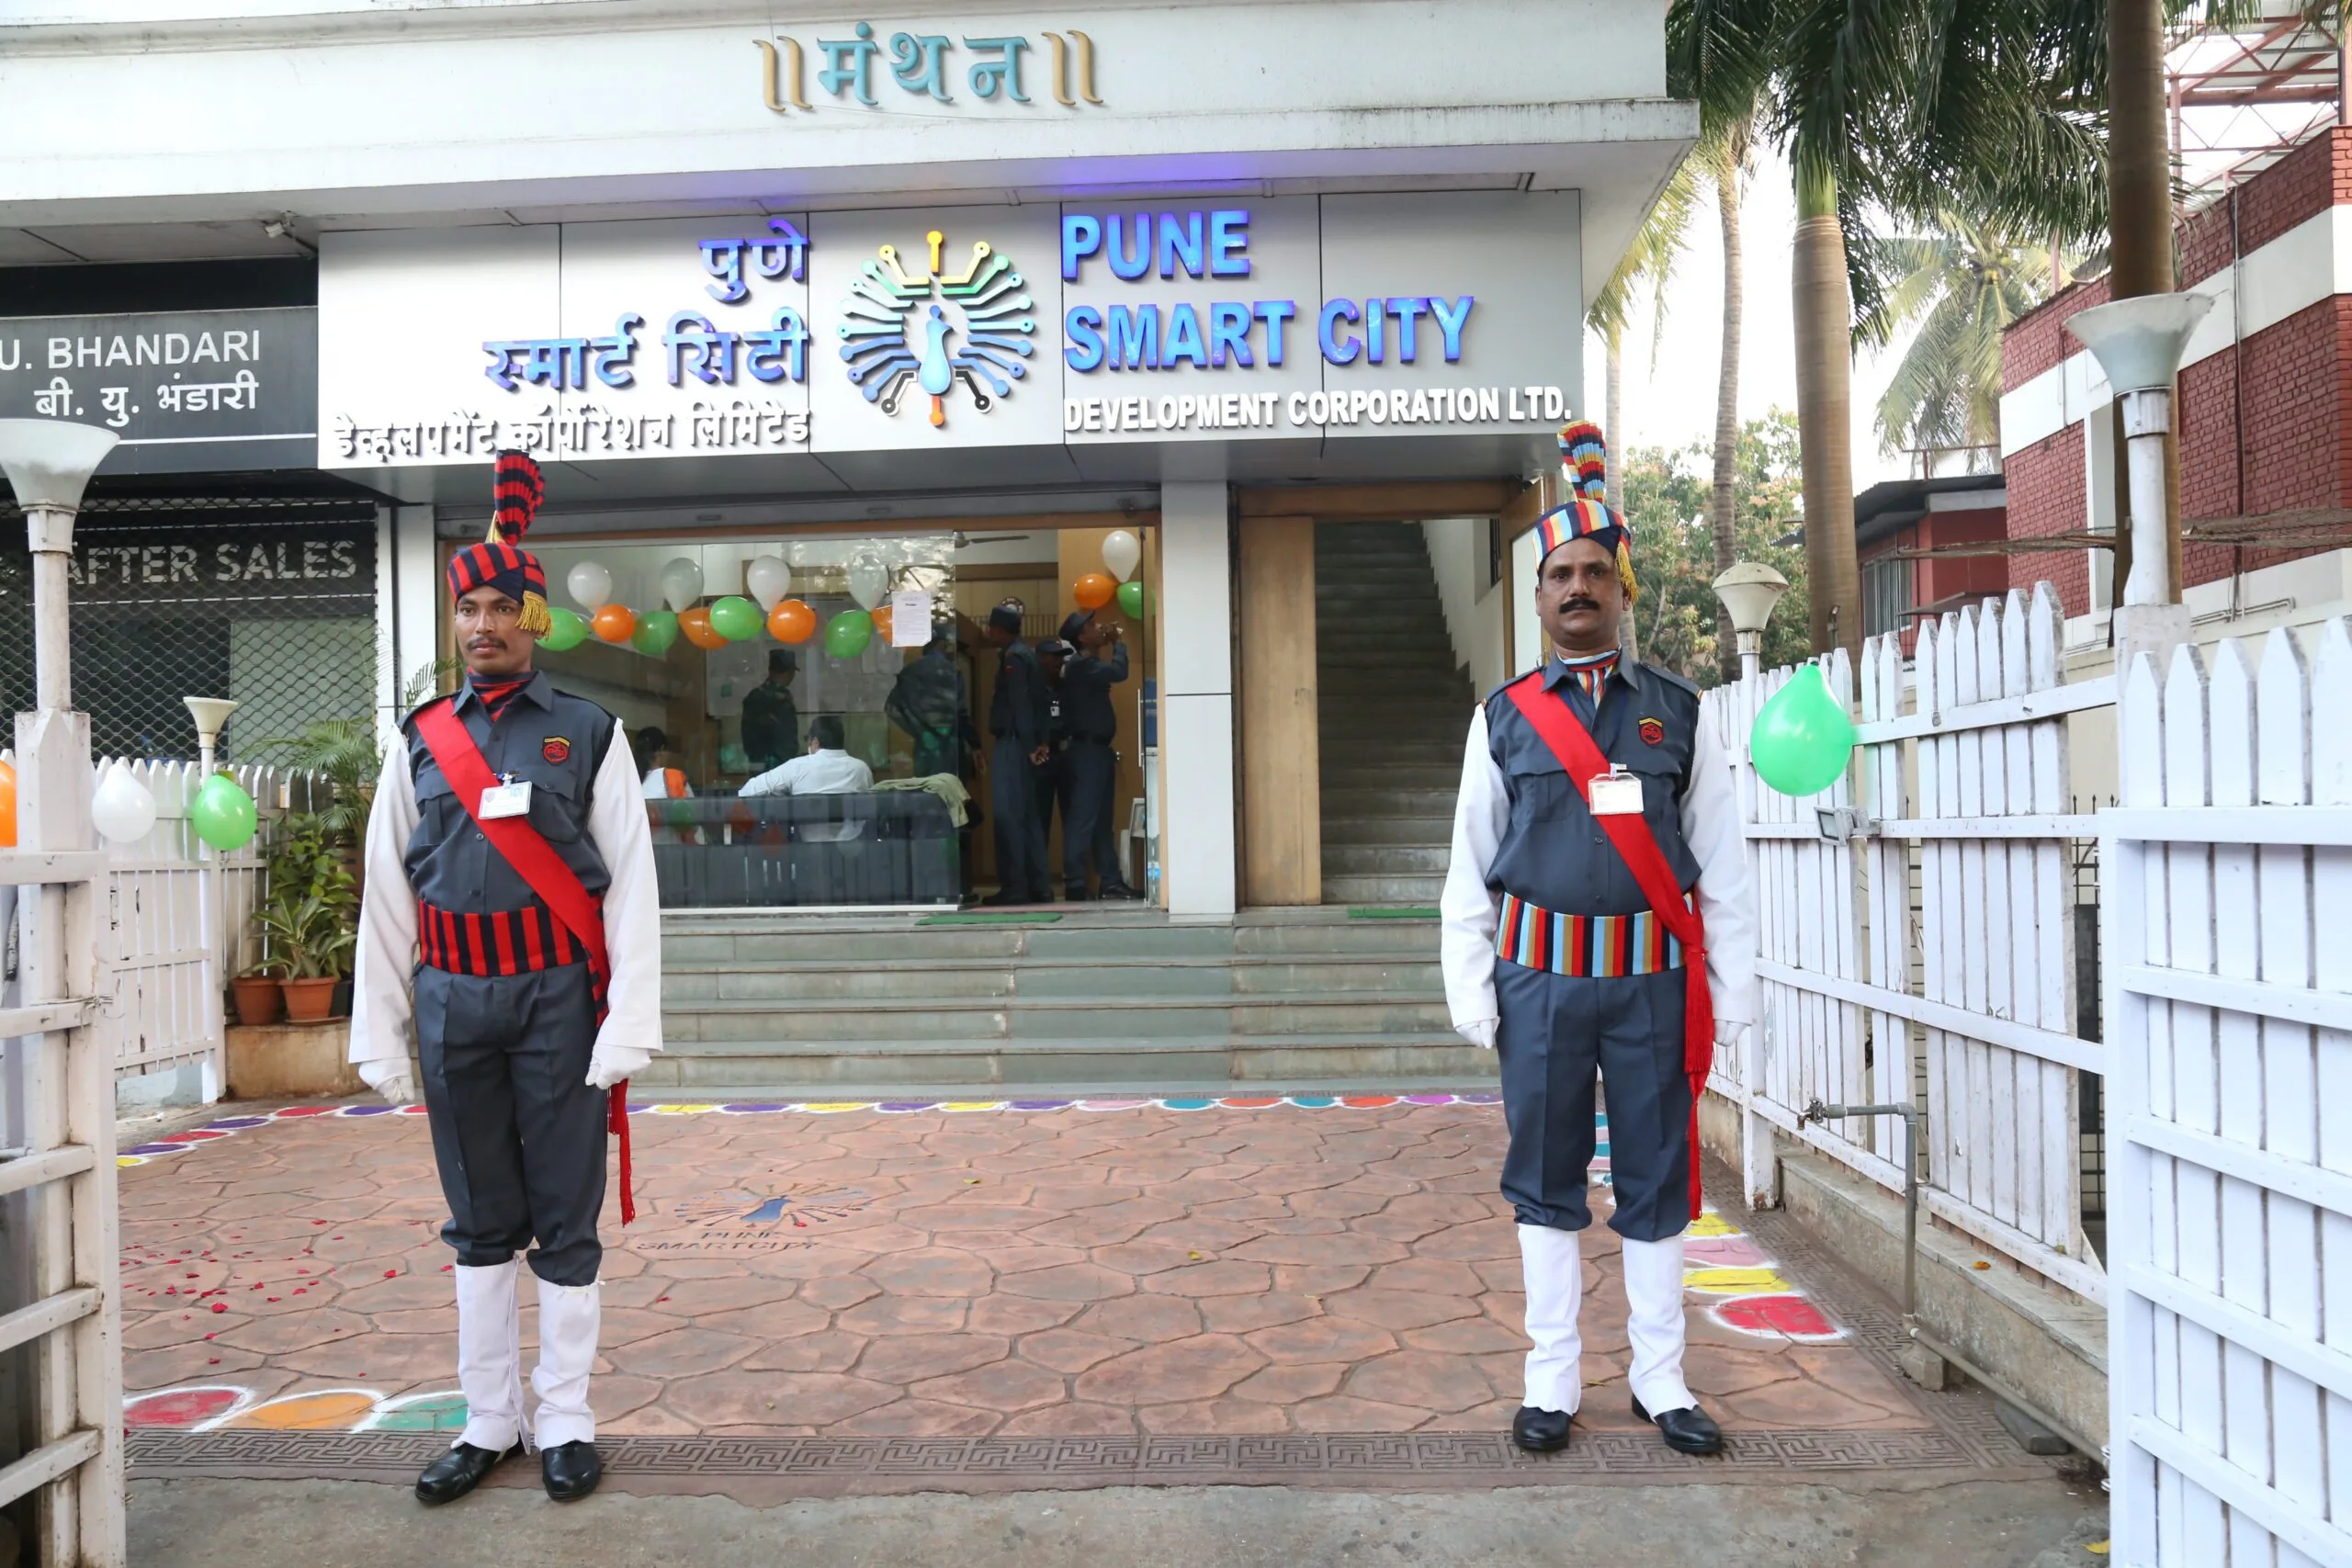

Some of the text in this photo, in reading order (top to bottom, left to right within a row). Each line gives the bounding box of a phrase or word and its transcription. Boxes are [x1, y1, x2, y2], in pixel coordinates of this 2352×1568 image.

[698, 218, 810, 304] पुणे
[1061, 209, 1251, 281] PUNE
[48, 330, 260, 369] BHANDARI
[481, 306, 811, 393] स्मार्ट सिटी
[1063, 296, 1475, 374] SMART CITY
[34, 368, 260, 428] बी. यु. भंडारी
[687, 400, 812, 447] लिमिटेड
[1064, 386, 1573, 433] DEVELOPMENT CORPORATION LTD.
[67, 539, 357, 586] AFTER SALES
